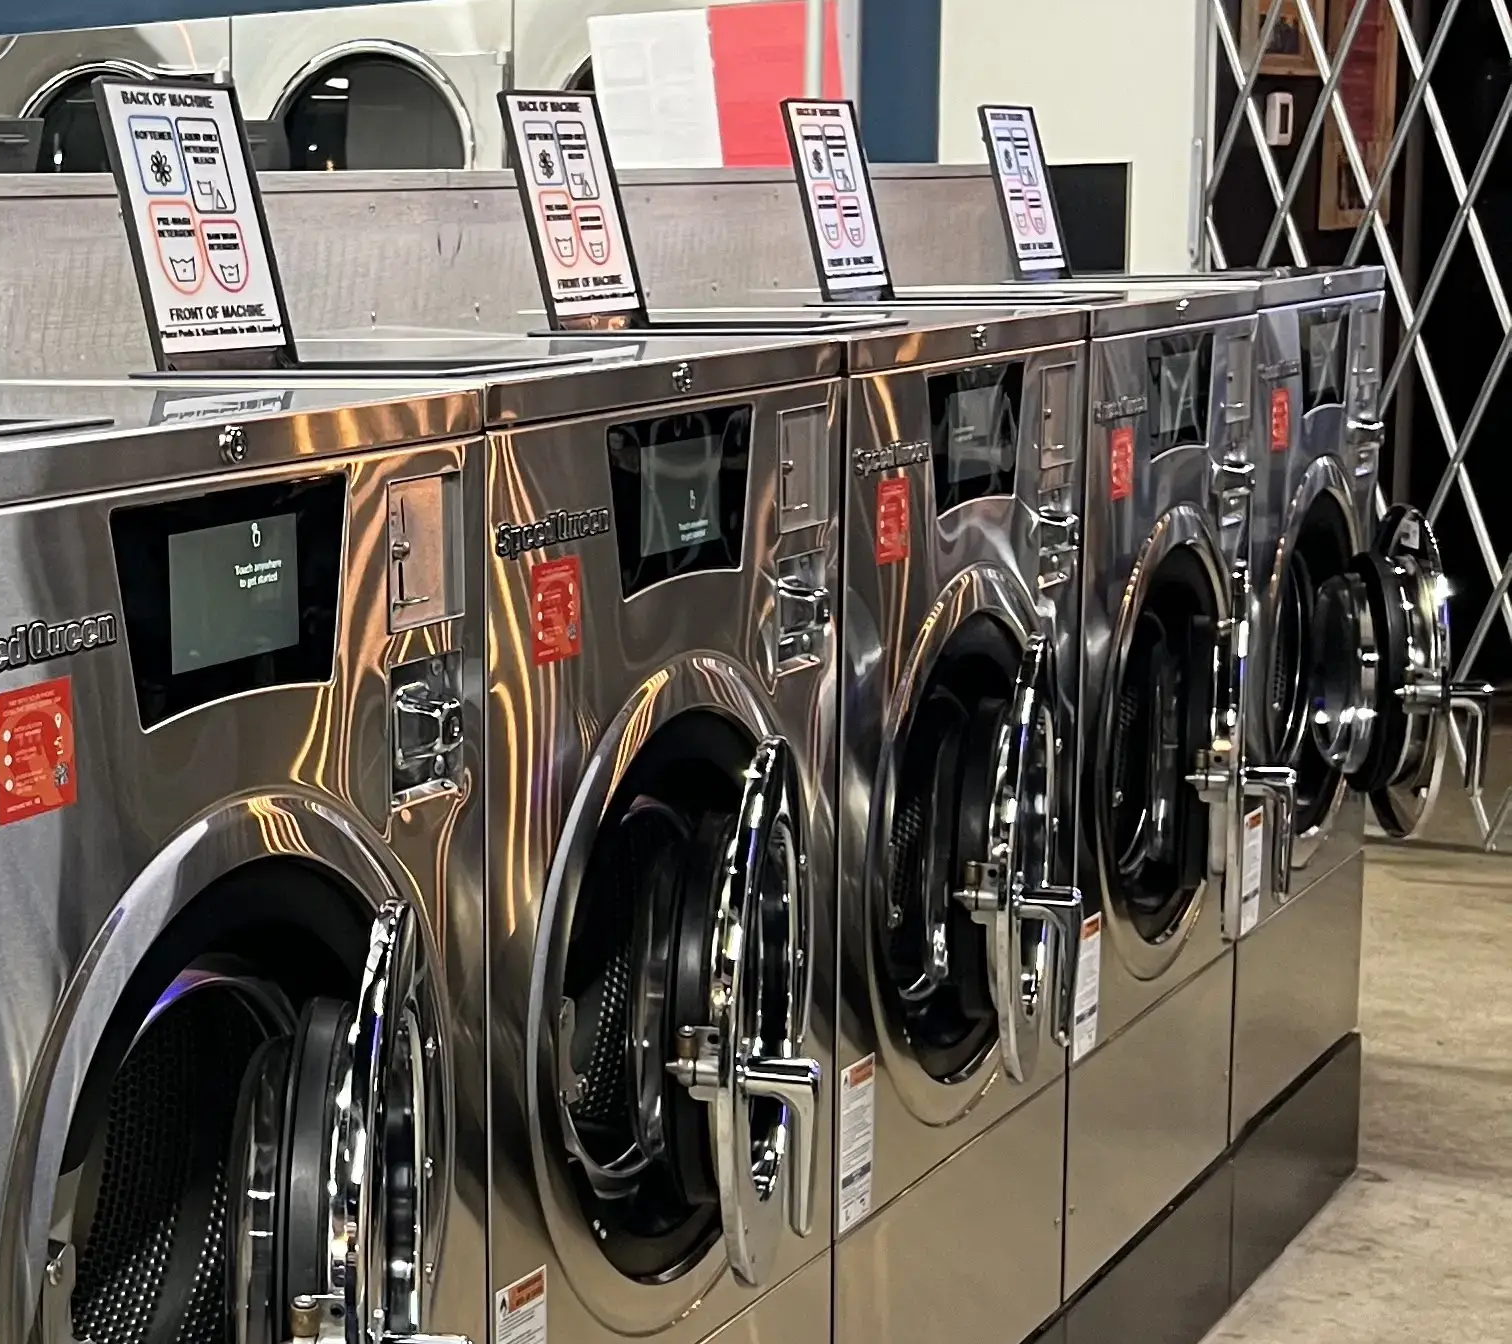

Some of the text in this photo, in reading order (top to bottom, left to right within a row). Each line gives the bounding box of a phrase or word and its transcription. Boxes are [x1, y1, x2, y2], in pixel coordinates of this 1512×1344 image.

[121, 91, 214, 109] BACK OF MACHINE
[169, 304, 266, 321] FRONT OF MACHINE
[496, 509, 608, 560] Speed Queen
[235, 563, 253, 575] Touch
[240, 571, 277, 588] to get started
[28, 612, 117, 664] Queen
